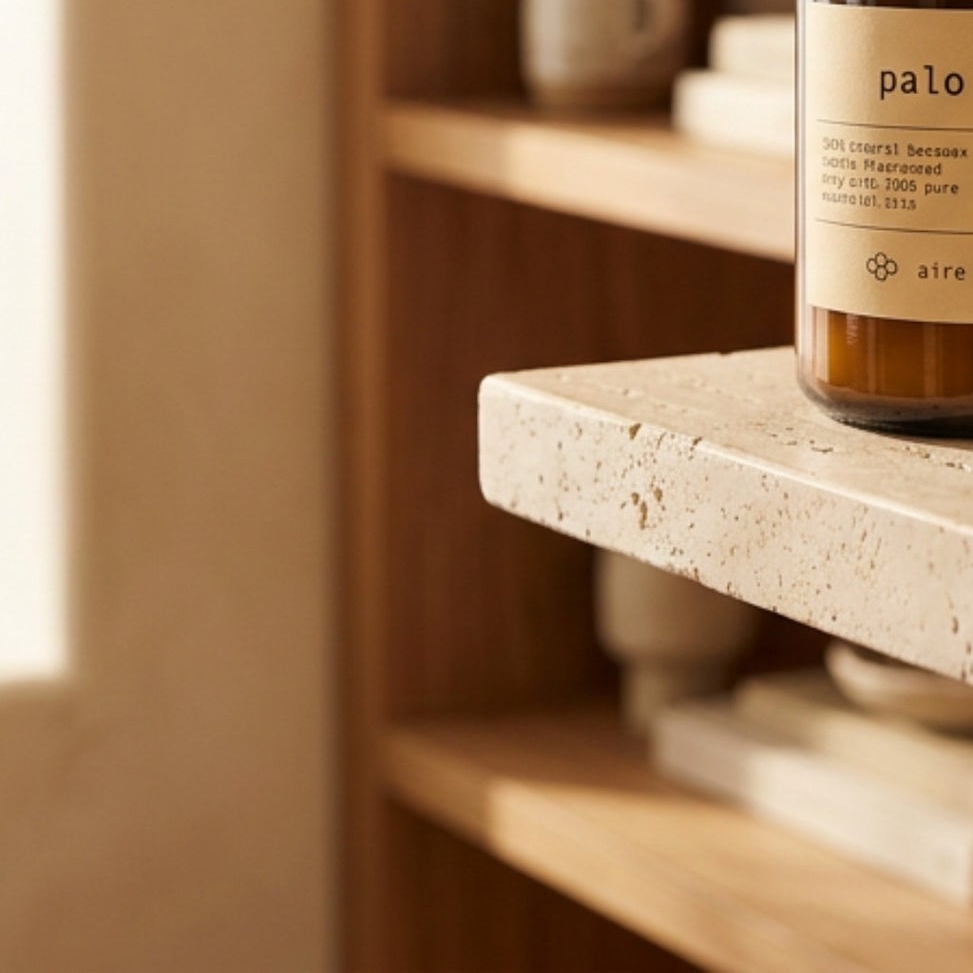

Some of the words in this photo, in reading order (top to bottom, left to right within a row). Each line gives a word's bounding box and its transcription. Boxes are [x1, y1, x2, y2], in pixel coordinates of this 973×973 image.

[880, 65, 965, 100] palo
[924, 183, 959, 196] pure
[917, 261, 966, 281] aire
